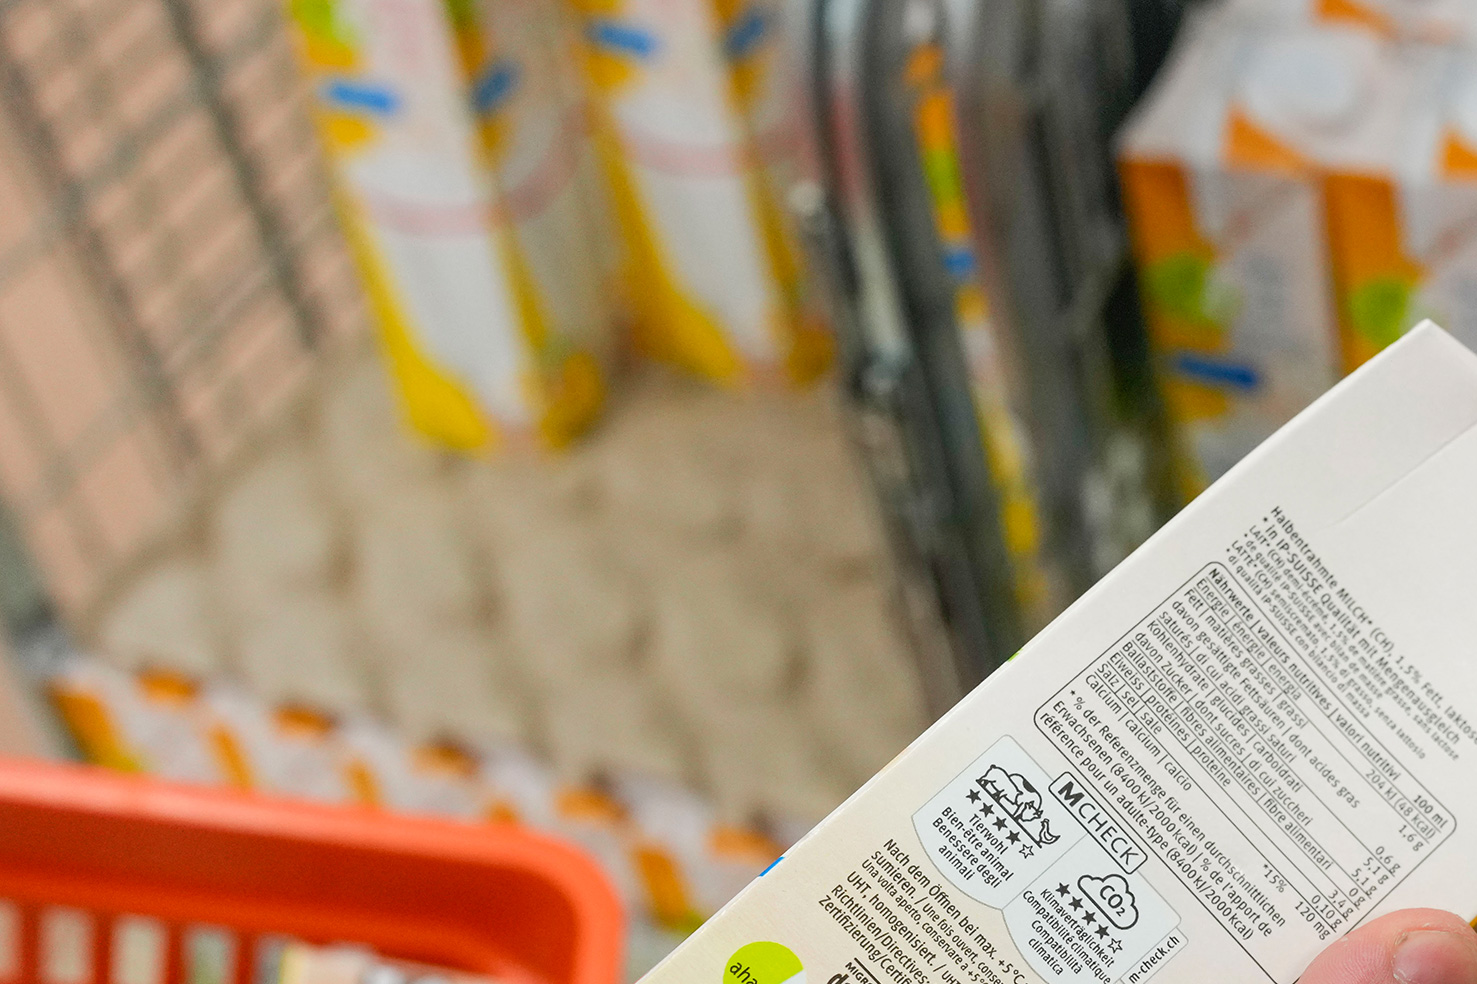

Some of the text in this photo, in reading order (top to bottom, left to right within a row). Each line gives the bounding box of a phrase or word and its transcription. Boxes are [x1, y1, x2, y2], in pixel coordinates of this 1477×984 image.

[931, 816, 1002, 889] Benessere degli
[940, 805, 1014, 882] Bien-être animal
[968, 812, 1009, 855] Tierwohl
[937, 844, 976, 881] animali
[1021, 889, 1111, 984] Compatibilité climatique
[1030, 919, 1083, 975] Compatibilità
[1039, 887, 1115, 968] Klimaverträglichkeit
[1027, 937, 1064, 976] climatica
[1127, 935, 1180, 984] m-check.ch
